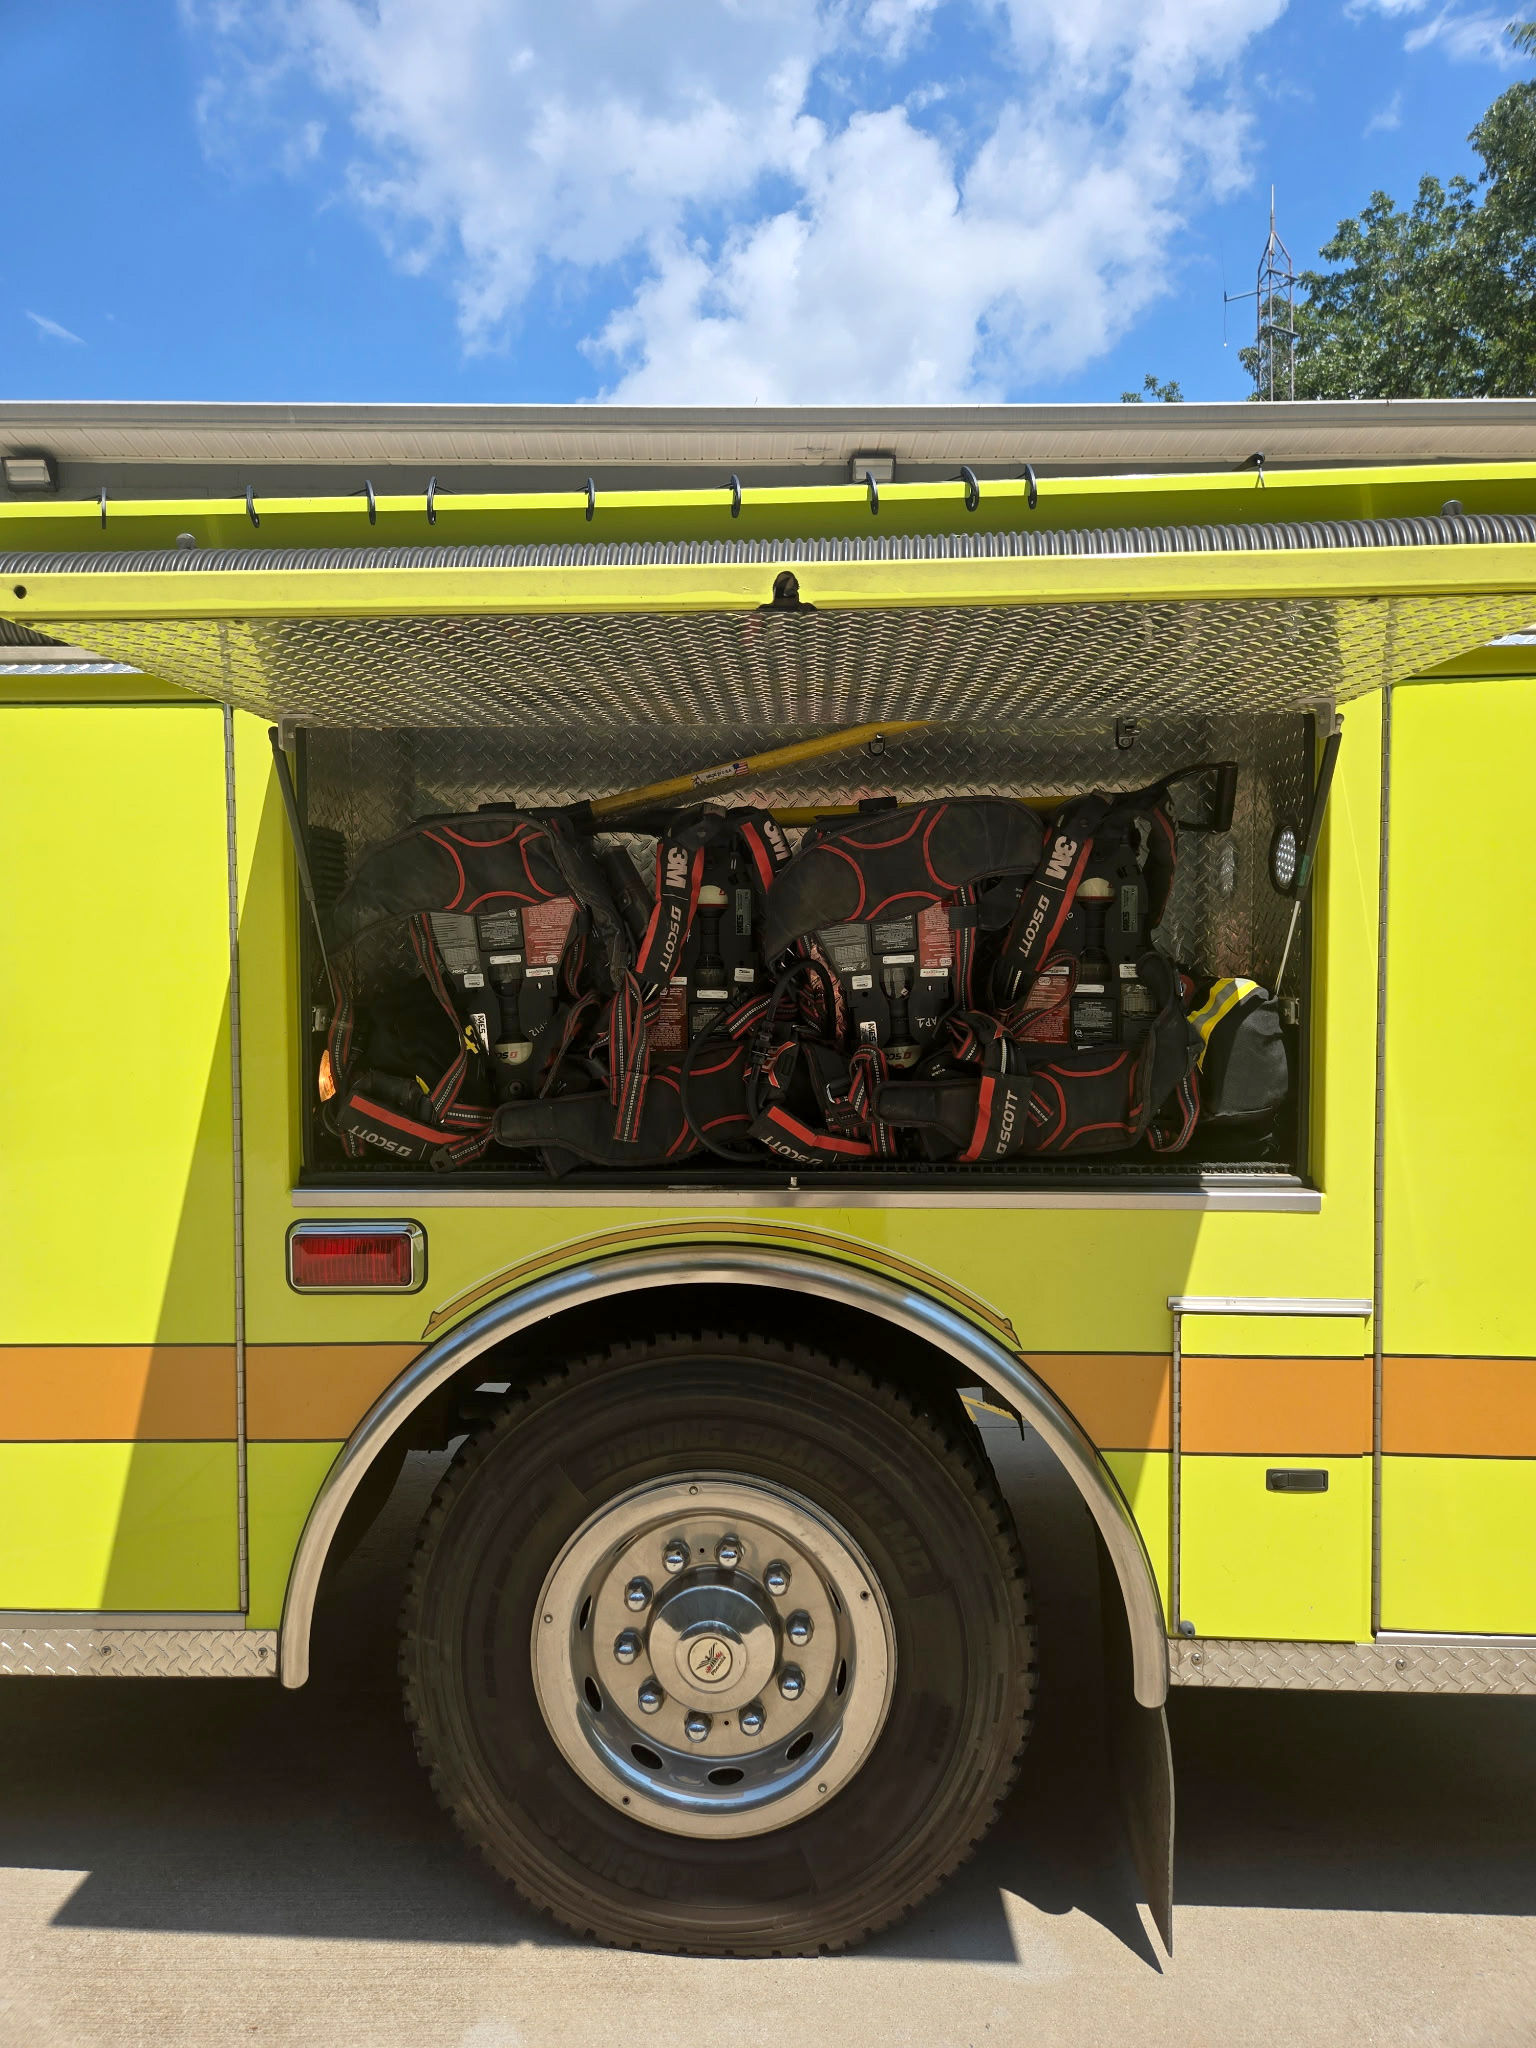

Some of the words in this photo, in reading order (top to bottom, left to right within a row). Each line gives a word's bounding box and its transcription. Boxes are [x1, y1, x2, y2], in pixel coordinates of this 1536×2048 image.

[763, 820, 792, 862] 3M
[1044, 835, 1078, 881] 3M
[664, 845, 688, 889] 3M
[659, 925, 681, 973] SCOTT
[1018, 907, 1046, 958] SCOTT
[477, 1015, 486, 1034] MES
[867, 1022, 877, 1042] MES
[1000, 1089, 1018, 1143] SCOTT
[347, 1124, 399, 1153] SCOTT
[760, 1134, 809, 1163] SCOTT
[710, 1655, 727, 1676] Phoenix
